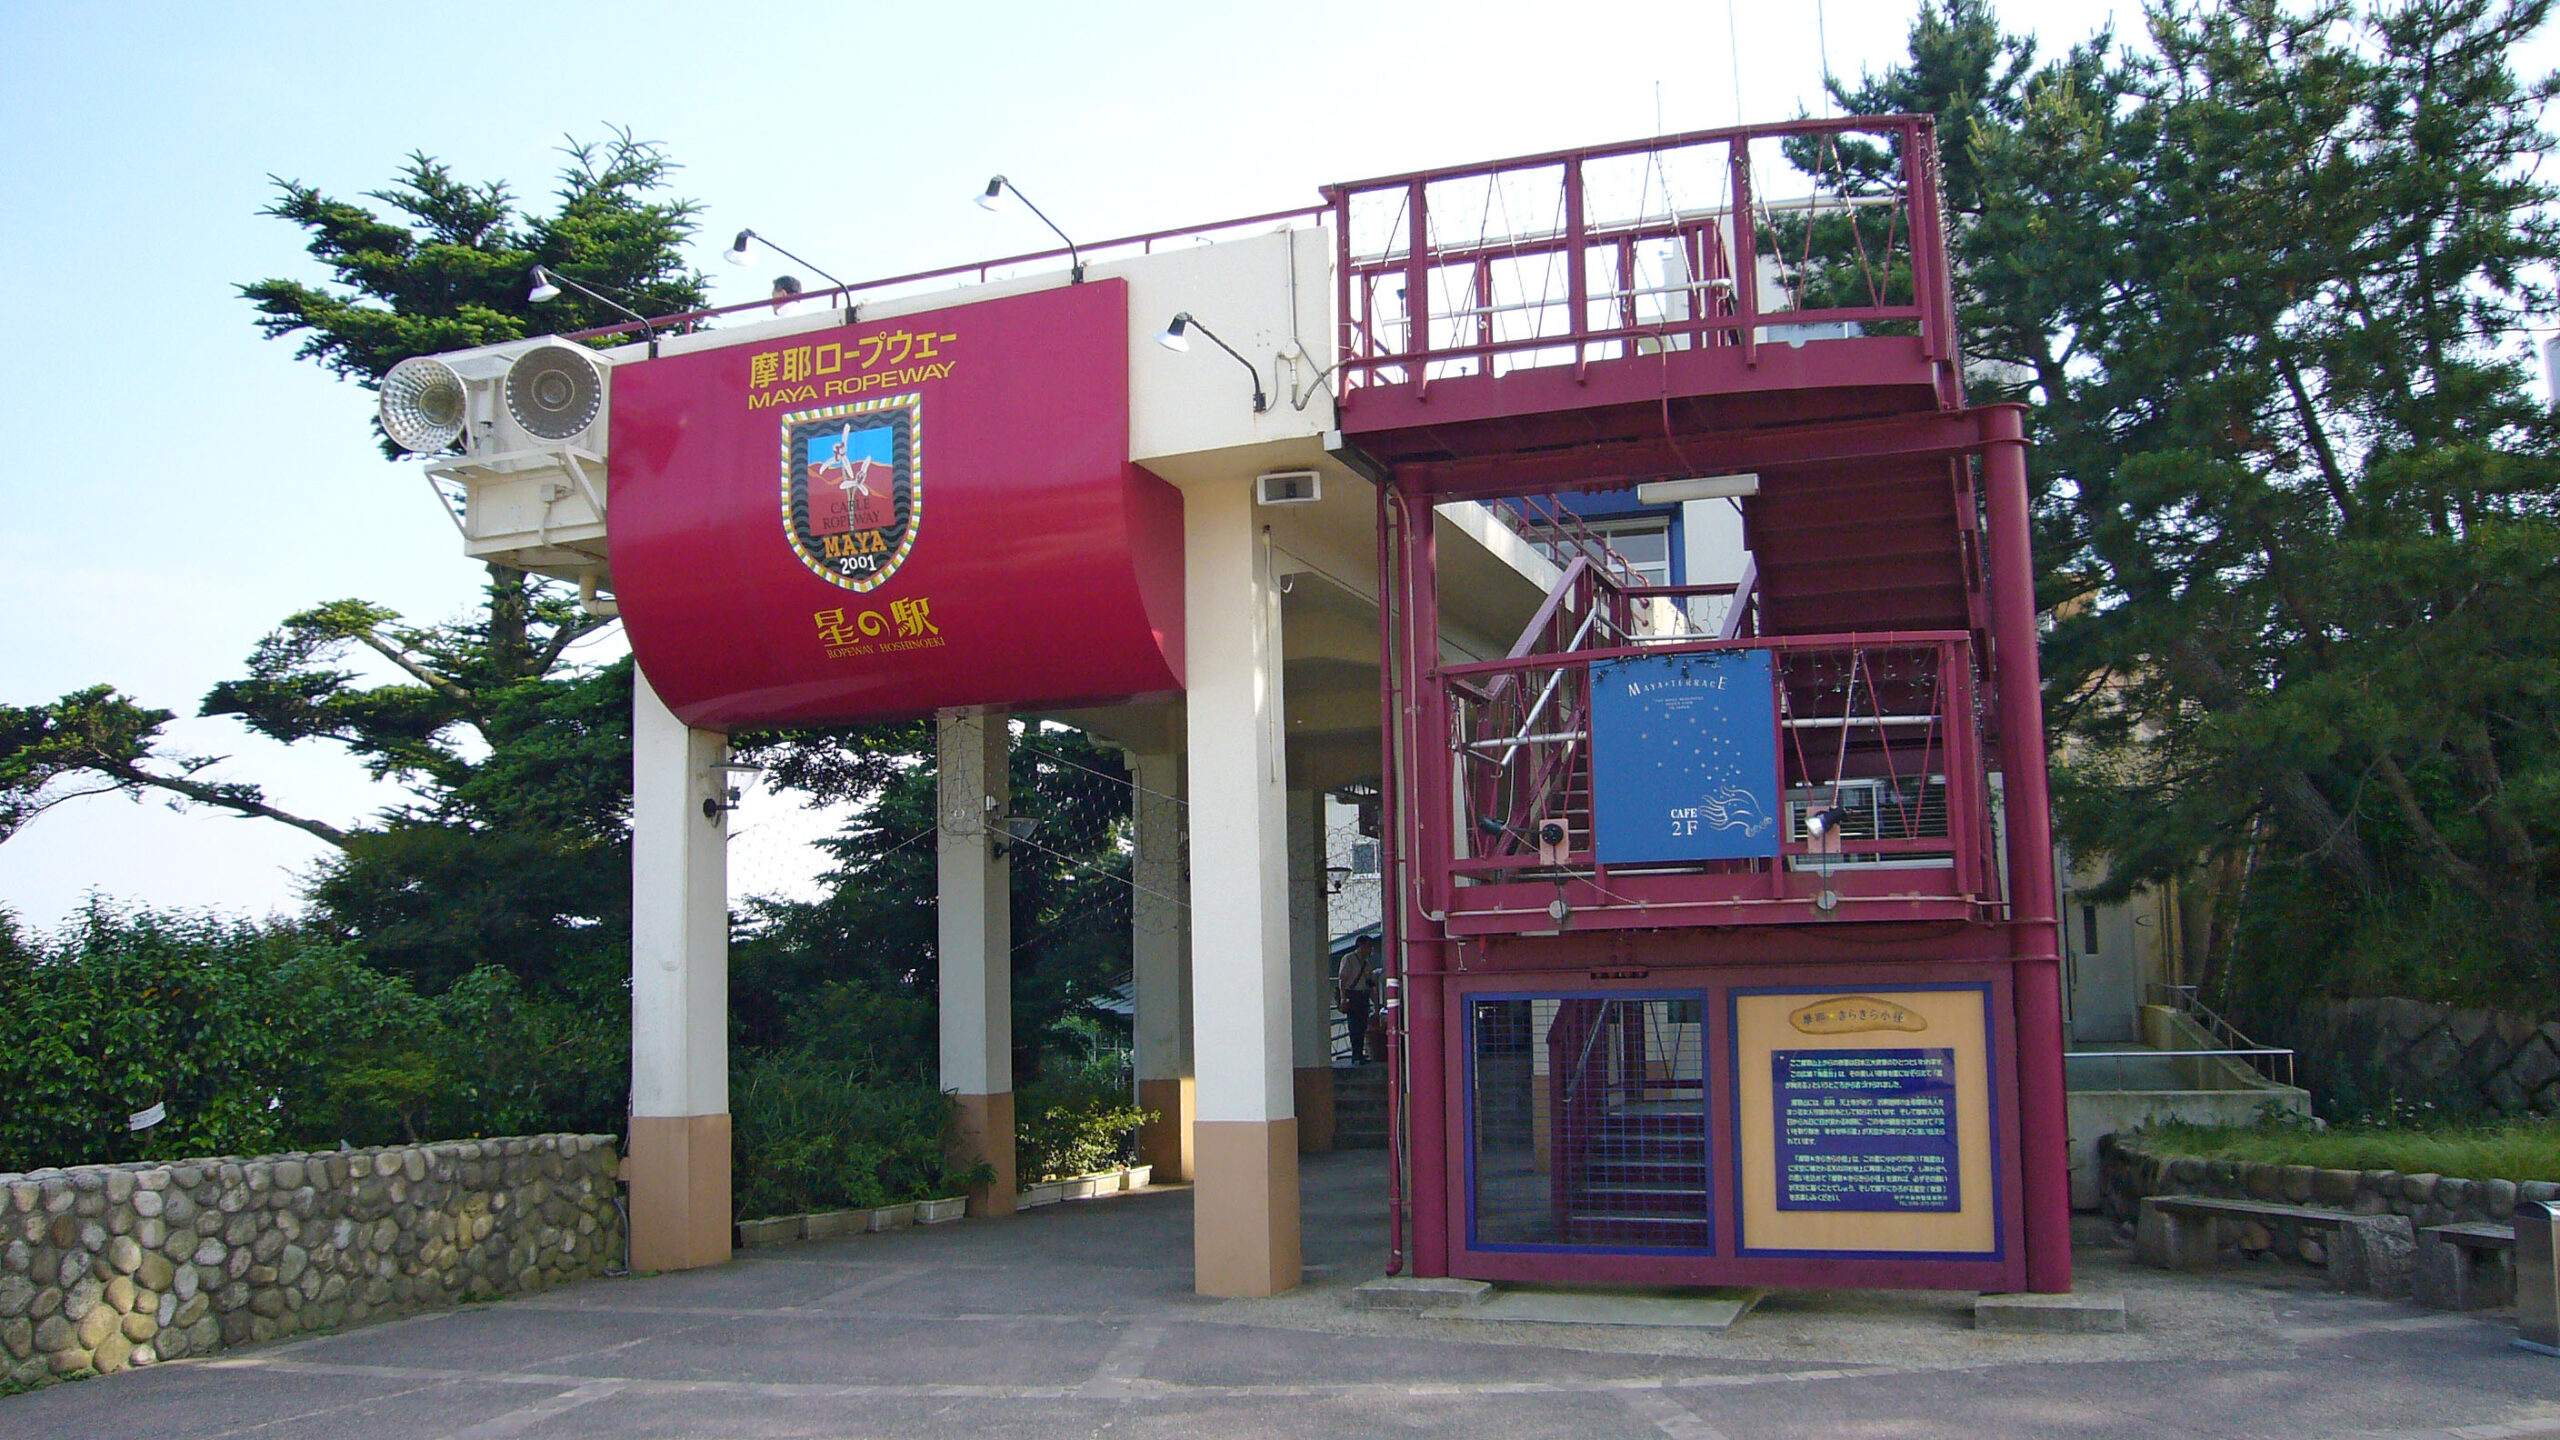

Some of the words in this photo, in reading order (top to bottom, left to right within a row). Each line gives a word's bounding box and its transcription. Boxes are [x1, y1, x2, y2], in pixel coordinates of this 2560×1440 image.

[749, 385, 818, 410] MAYA
[825, 361, 956, 397] ROPEWAY
[823, 530, 888, 559] MAYA
[840, 555, 877, 575] 2001
[814, 597, 939, 648] 星の駅
[826, 645, 875, 660] ROPEWAY
[879, 636, 946, 653] HOSHINOEKI
[1670, 807, 1698, 819] CAFE
